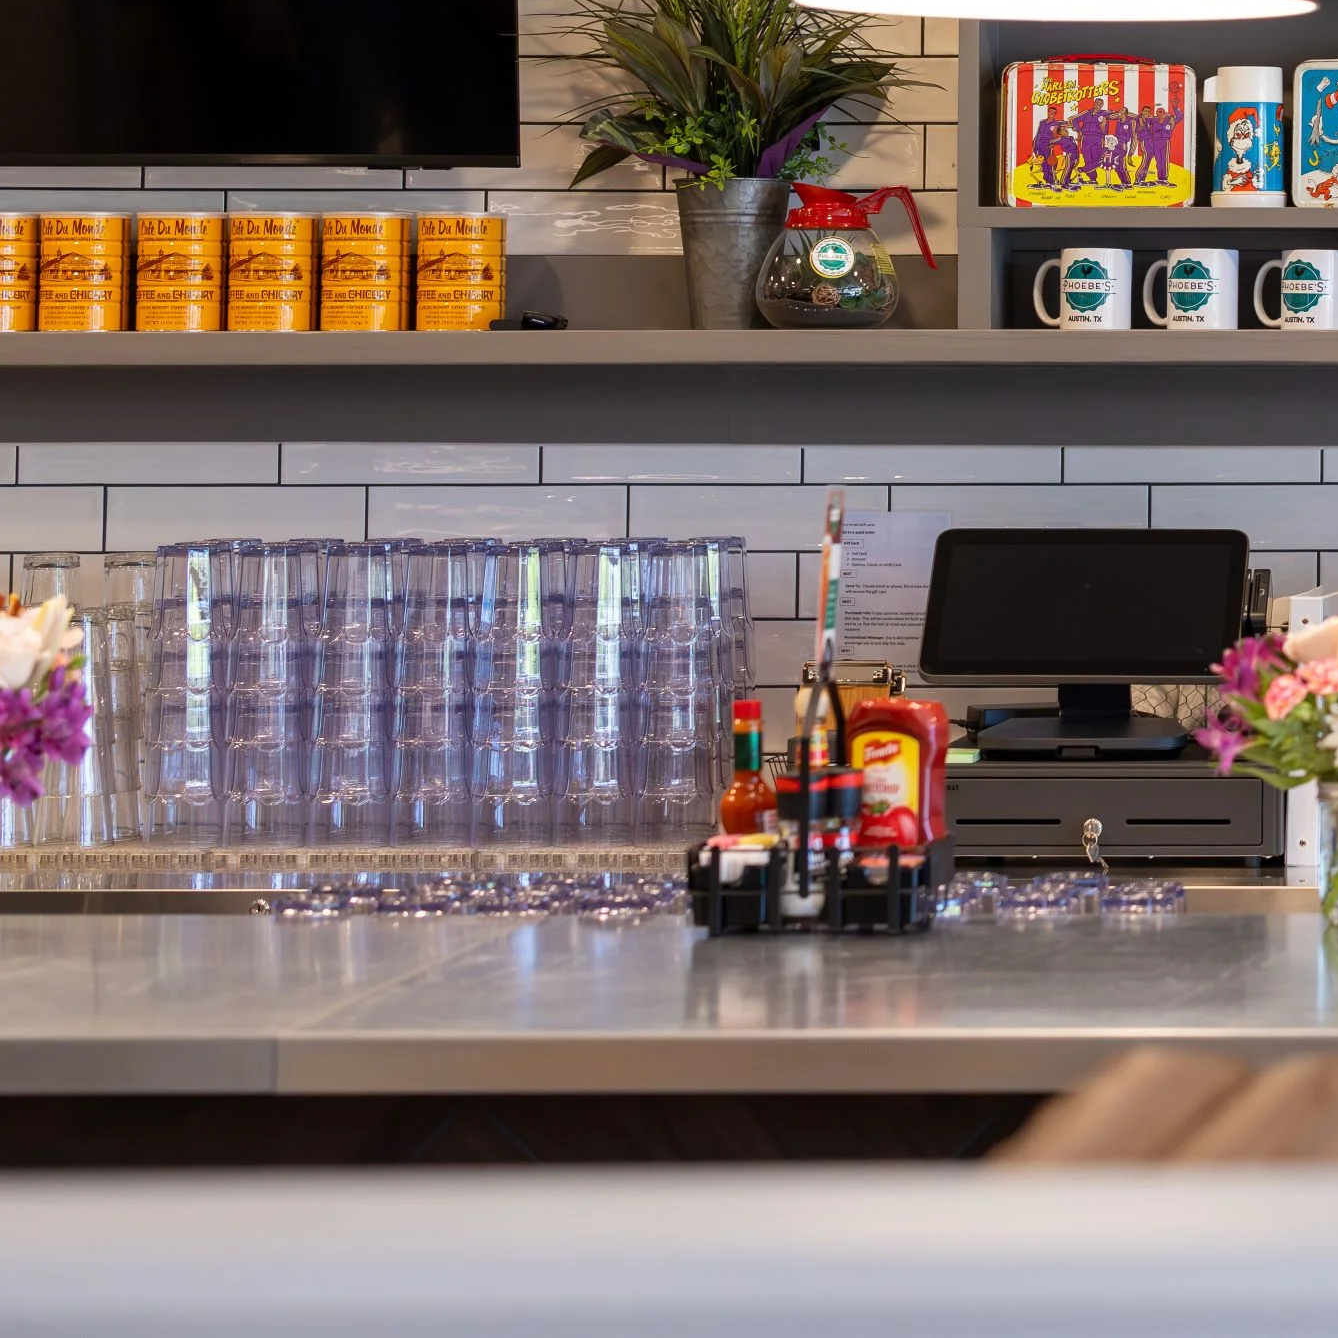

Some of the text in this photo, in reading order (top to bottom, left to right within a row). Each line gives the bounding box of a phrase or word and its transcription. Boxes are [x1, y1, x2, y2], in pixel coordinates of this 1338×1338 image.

[1041, 80, 1076, 91] HARLEM
[1031, 81, 1119, 106] GLOBETROTTERS
[56, 220, 68, 235] Du
[157, 220, 171, 235] Du
[246, 220, 297, 235] Du Monde
[335, 220, 384, 235] Du Monde
[438, 220, 488, 235] Du Monde
[1063, 280, 1111, 292] PHOEBE'S
[1169, 280, 1214, 291] PHOEBE'S
